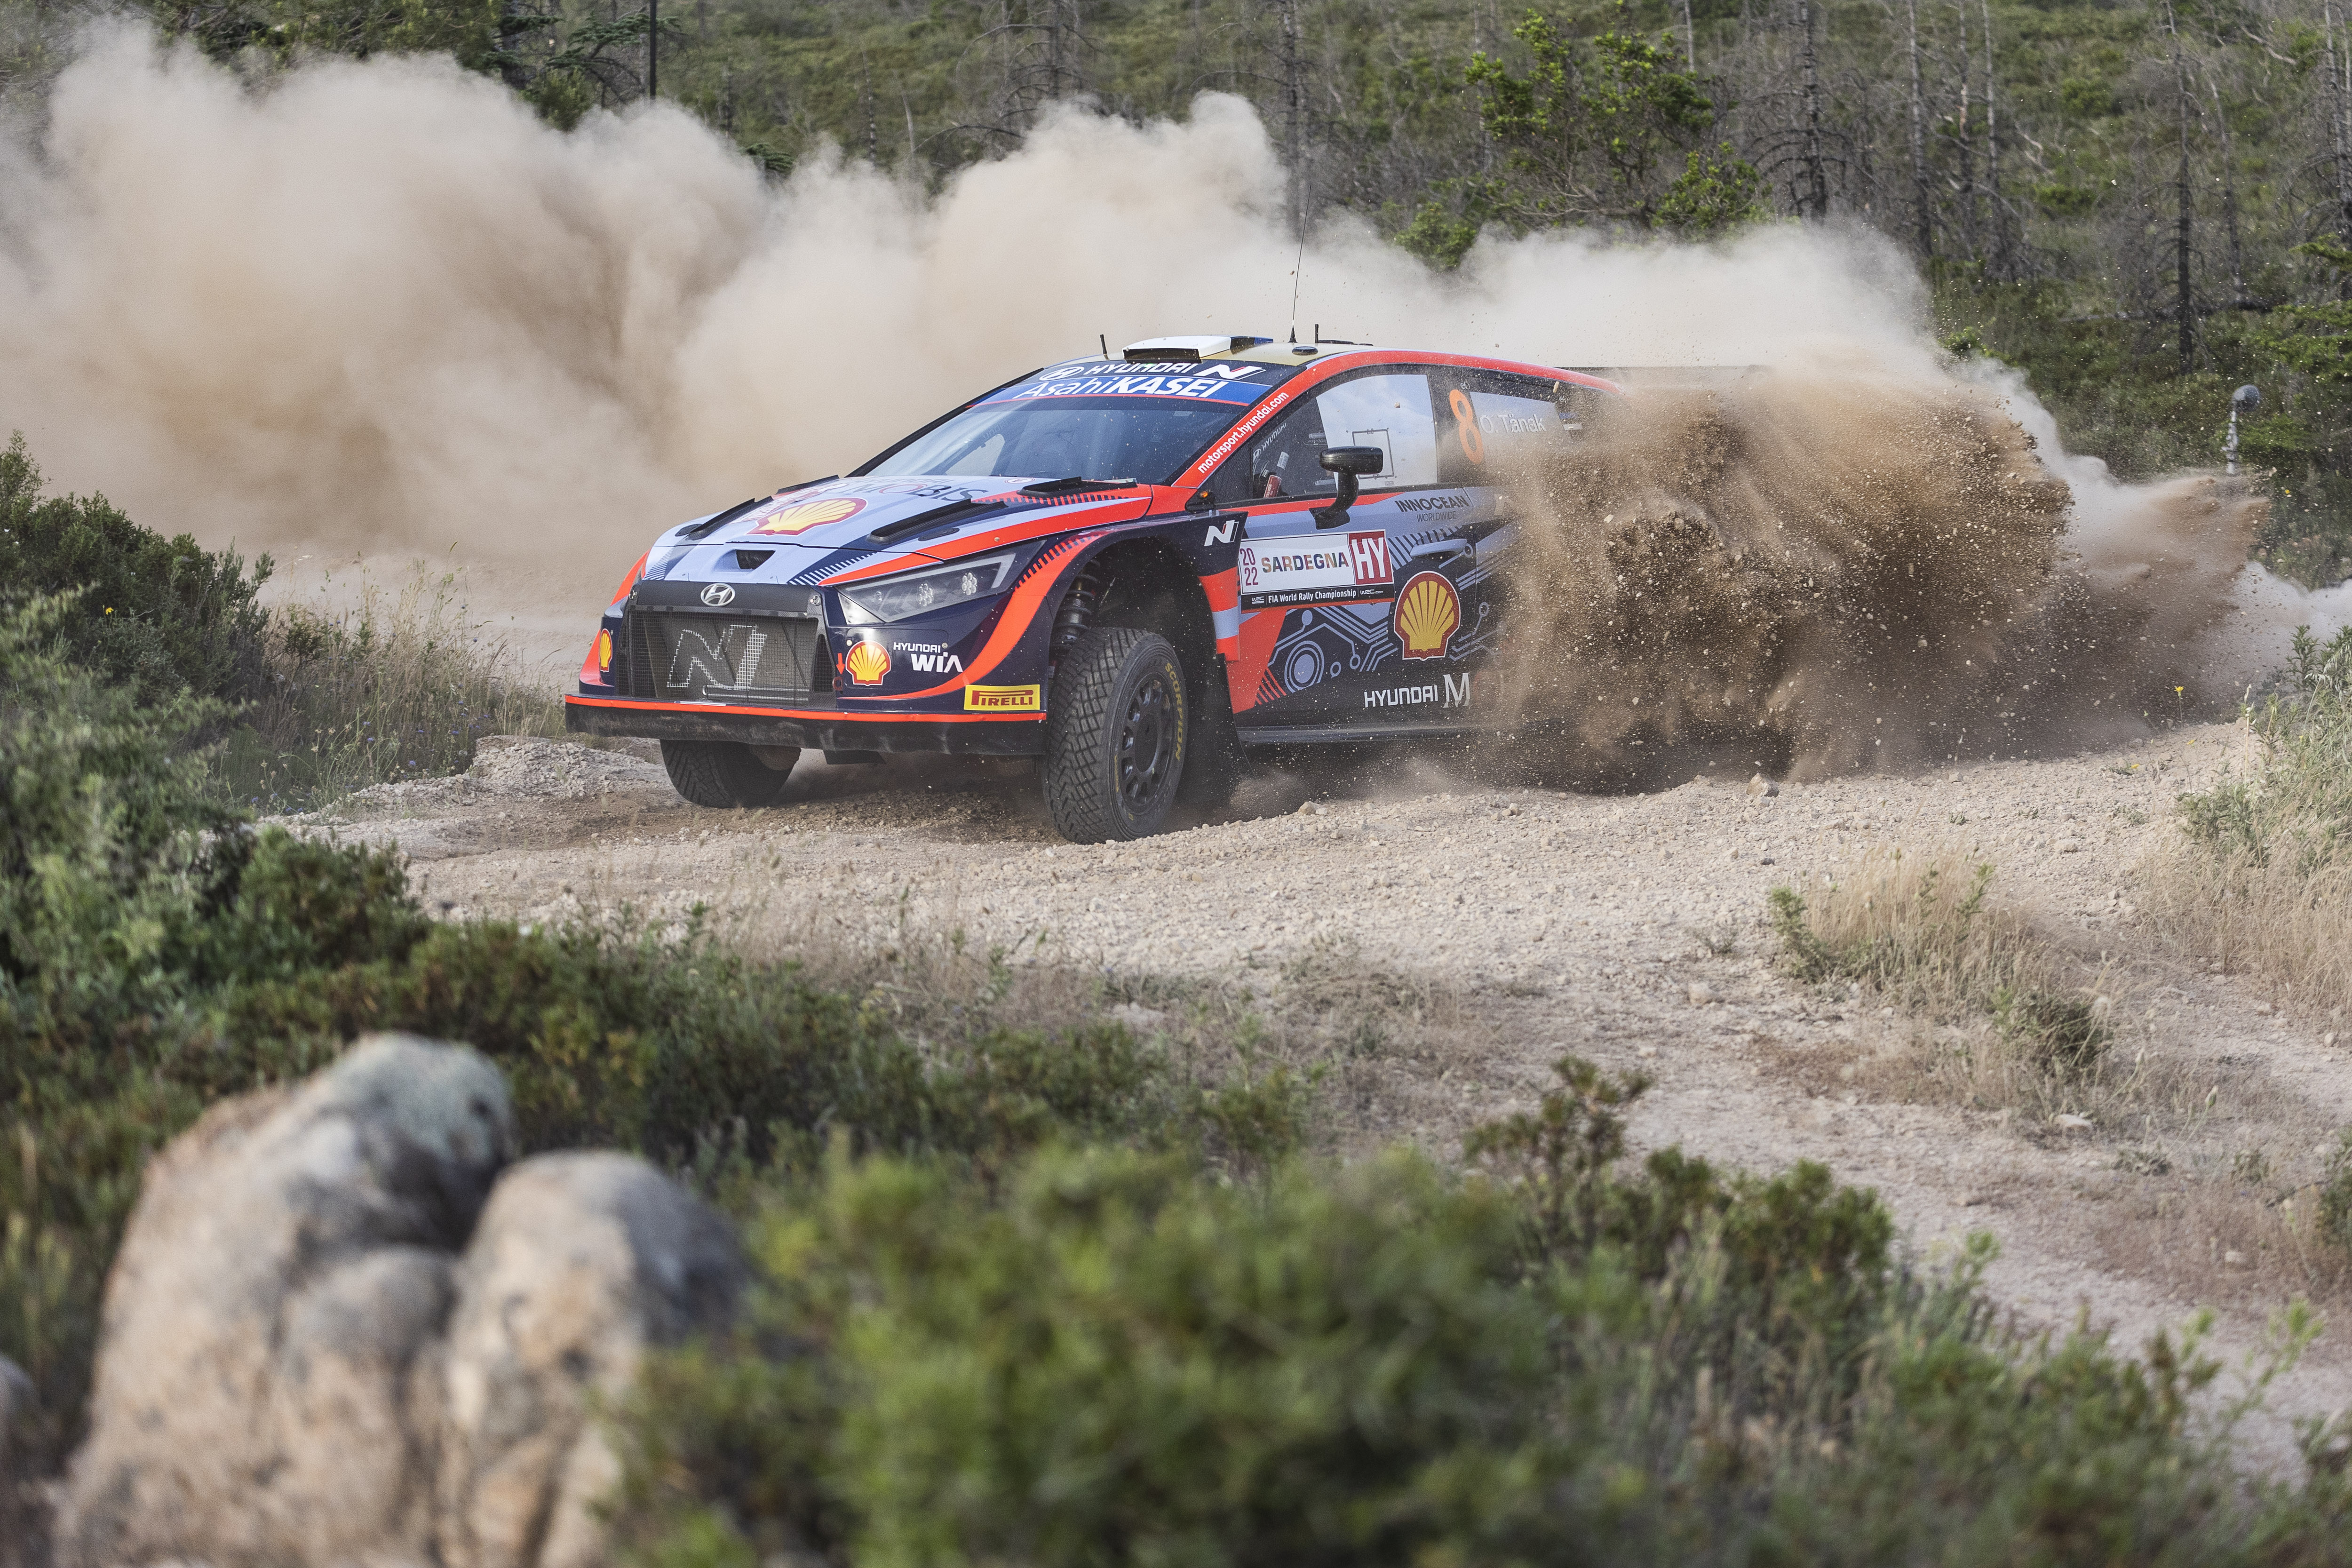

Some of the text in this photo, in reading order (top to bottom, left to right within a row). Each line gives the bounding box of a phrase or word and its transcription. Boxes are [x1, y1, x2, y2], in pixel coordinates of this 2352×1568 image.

[1084, 362, 1199, 375] HYUNDAI
[1197, 391, 1289, 474] motorsport.hyundai.com
[1449, 389, 1484, 464] 8
[1499, 413, 1547, 434] Tänak
[1394, 495, 1470, 512] INNOCEAN
[1416, 511, 1457, 522] WORLDWIDE
[1240, 547, 1256, 566] 20
[1261, 551, 1350, 573] SARDEGNA
[1351, 536, 1386, 580] HY
[1245, 566, 1259, 586] 22
[1268, 589, 1357, 604] FIA World Rally Championship
[893, 641, 941, 654] HYUNDAI
[910, 651, 964, 674] WIA
[971, 689, 1033, 707] PIRELLI
[1364, 684, 1438, 708] HYUNDAI
[1165, 662, 1184, 761] SCORPION
